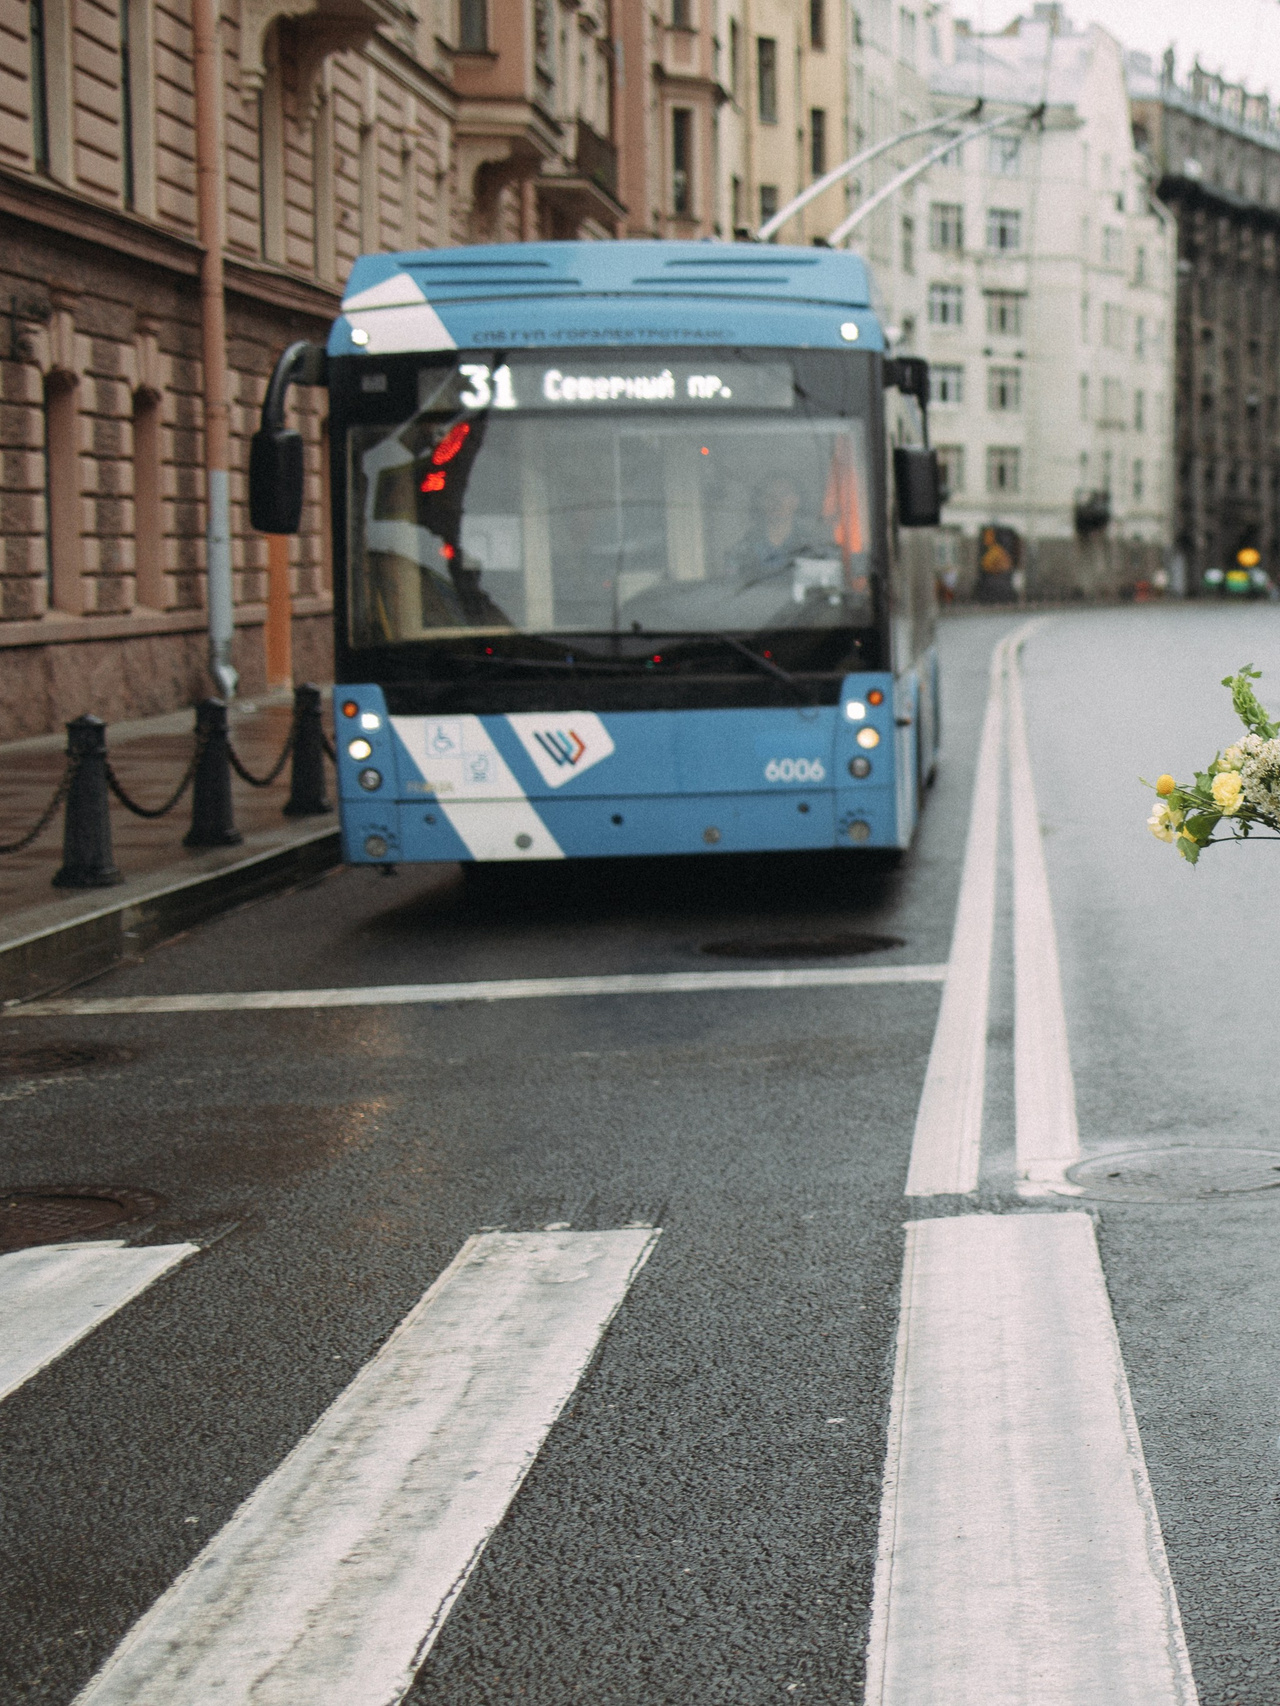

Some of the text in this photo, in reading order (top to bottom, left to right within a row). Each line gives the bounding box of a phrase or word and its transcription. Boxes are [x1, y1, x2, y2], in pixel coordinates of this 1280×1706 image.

[459, 364, 516, 409] 31
[544, 369, 675, 400] Северный
[765, 758, 825, 781] 6006
